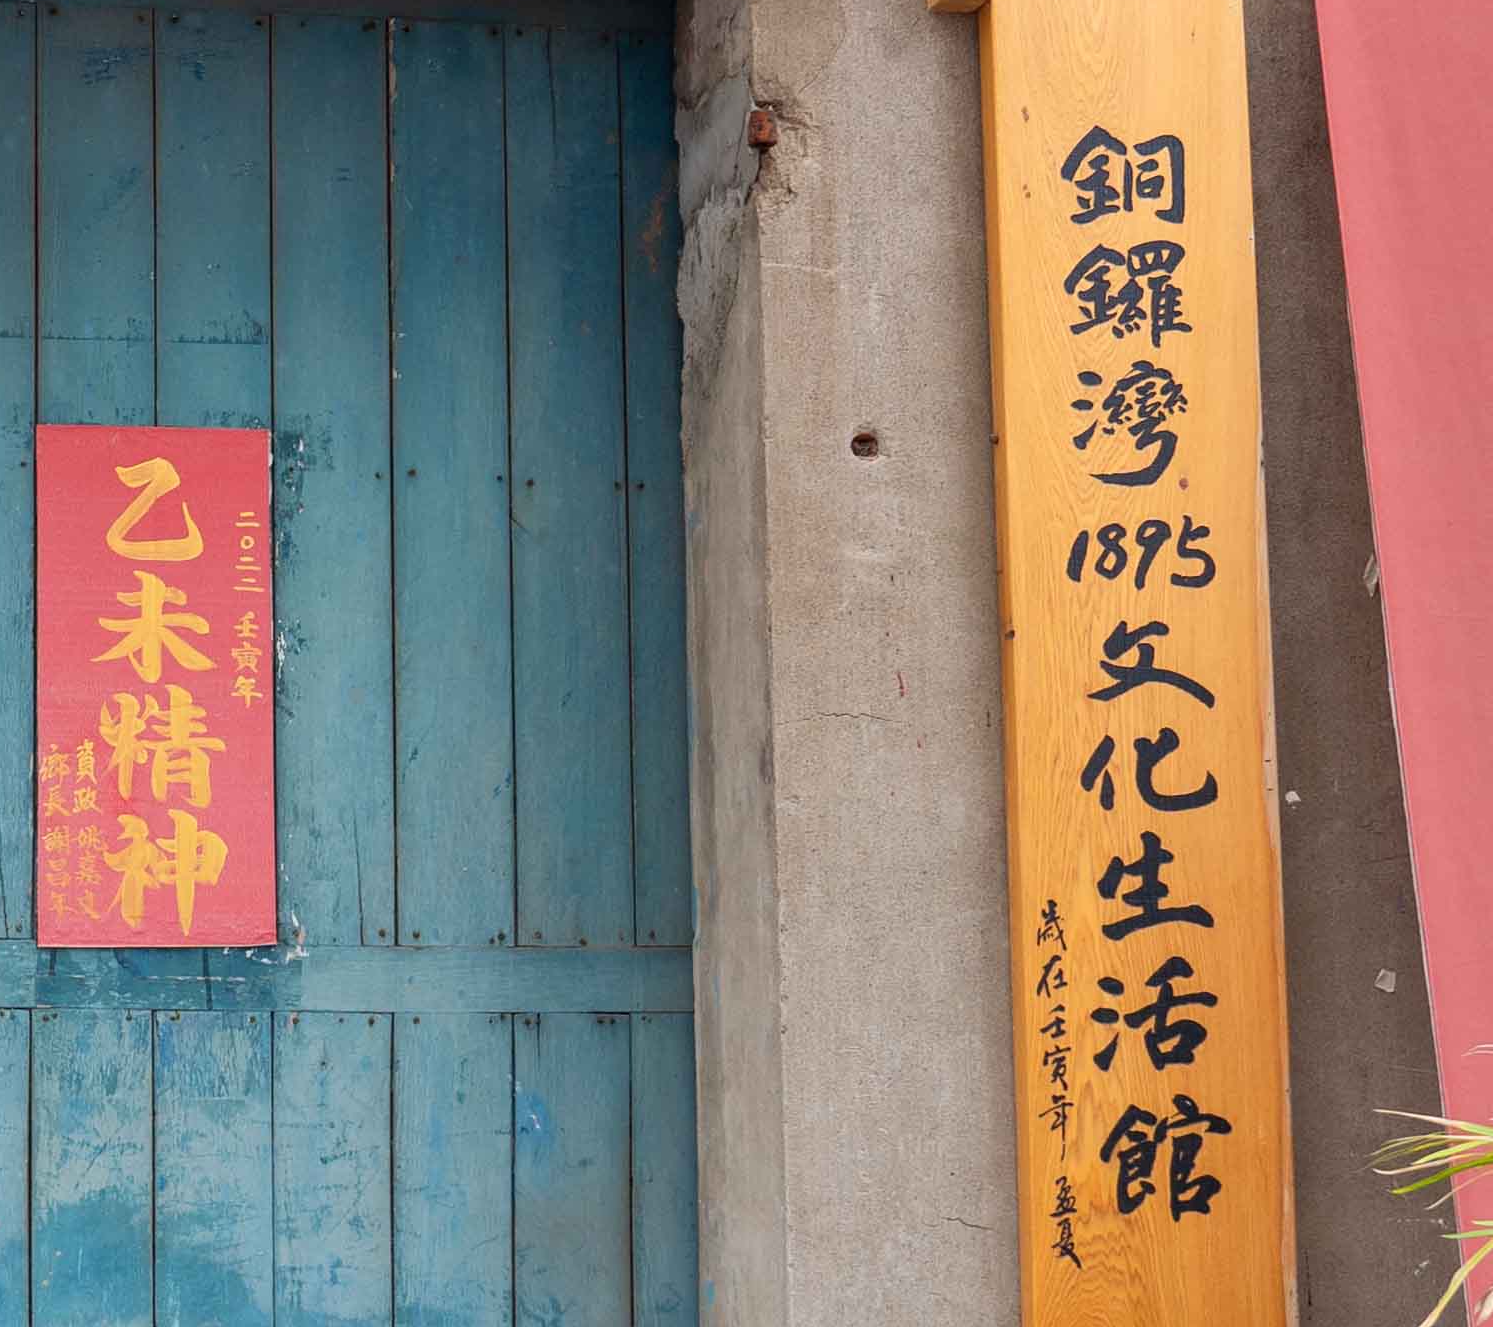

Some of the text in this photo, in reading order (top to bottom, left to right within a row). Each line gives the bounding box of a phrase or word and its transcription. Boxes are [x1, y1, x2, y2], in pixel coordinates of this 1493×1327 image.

[91, 457, 228, 936] 乙未精神
[1060, 125, 1232, 1222] 銅鑼灣1895文化生活館
